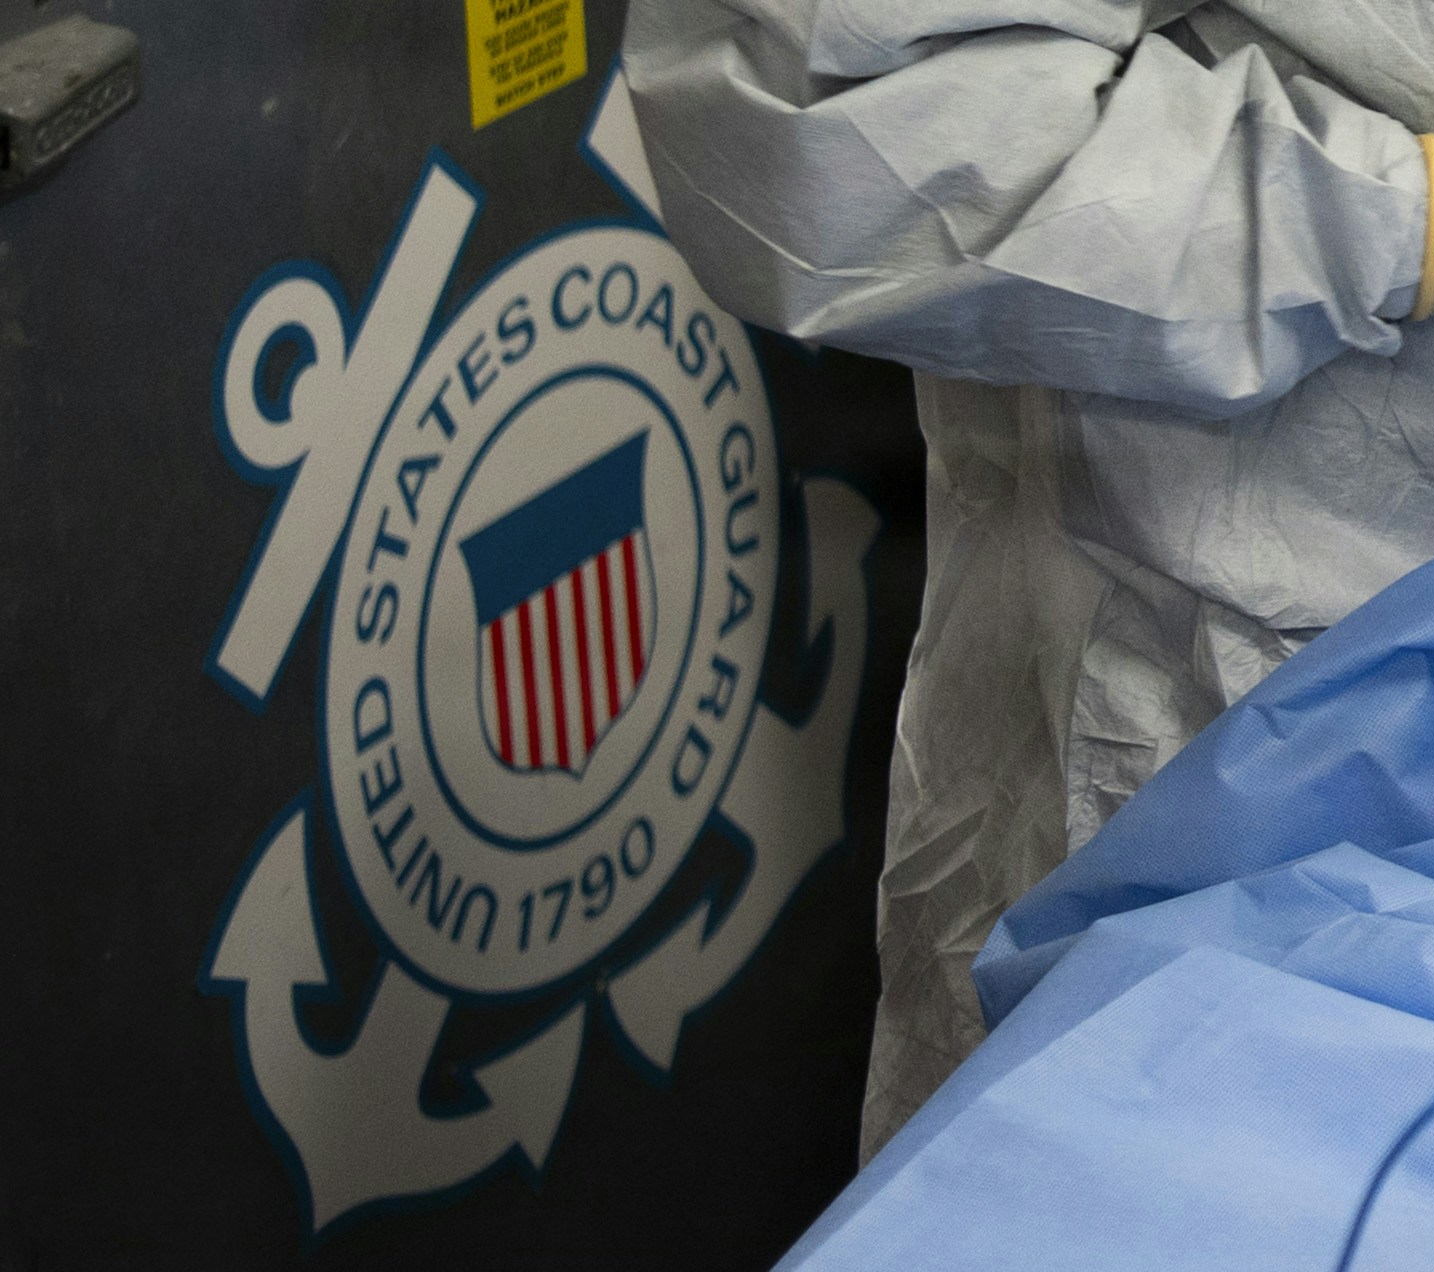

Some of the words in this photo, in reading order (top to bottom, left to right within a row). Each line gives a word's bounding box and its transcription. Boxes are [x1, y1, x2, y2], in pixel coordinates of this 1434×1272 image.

[356, 293, 540, 644] STATES
[551, 261, 742, 417] COAST
[669, 420, 758, 800] GUARD
[352, 675, 499, 953] UNITED
[516, 815, 657, 953] 1790
